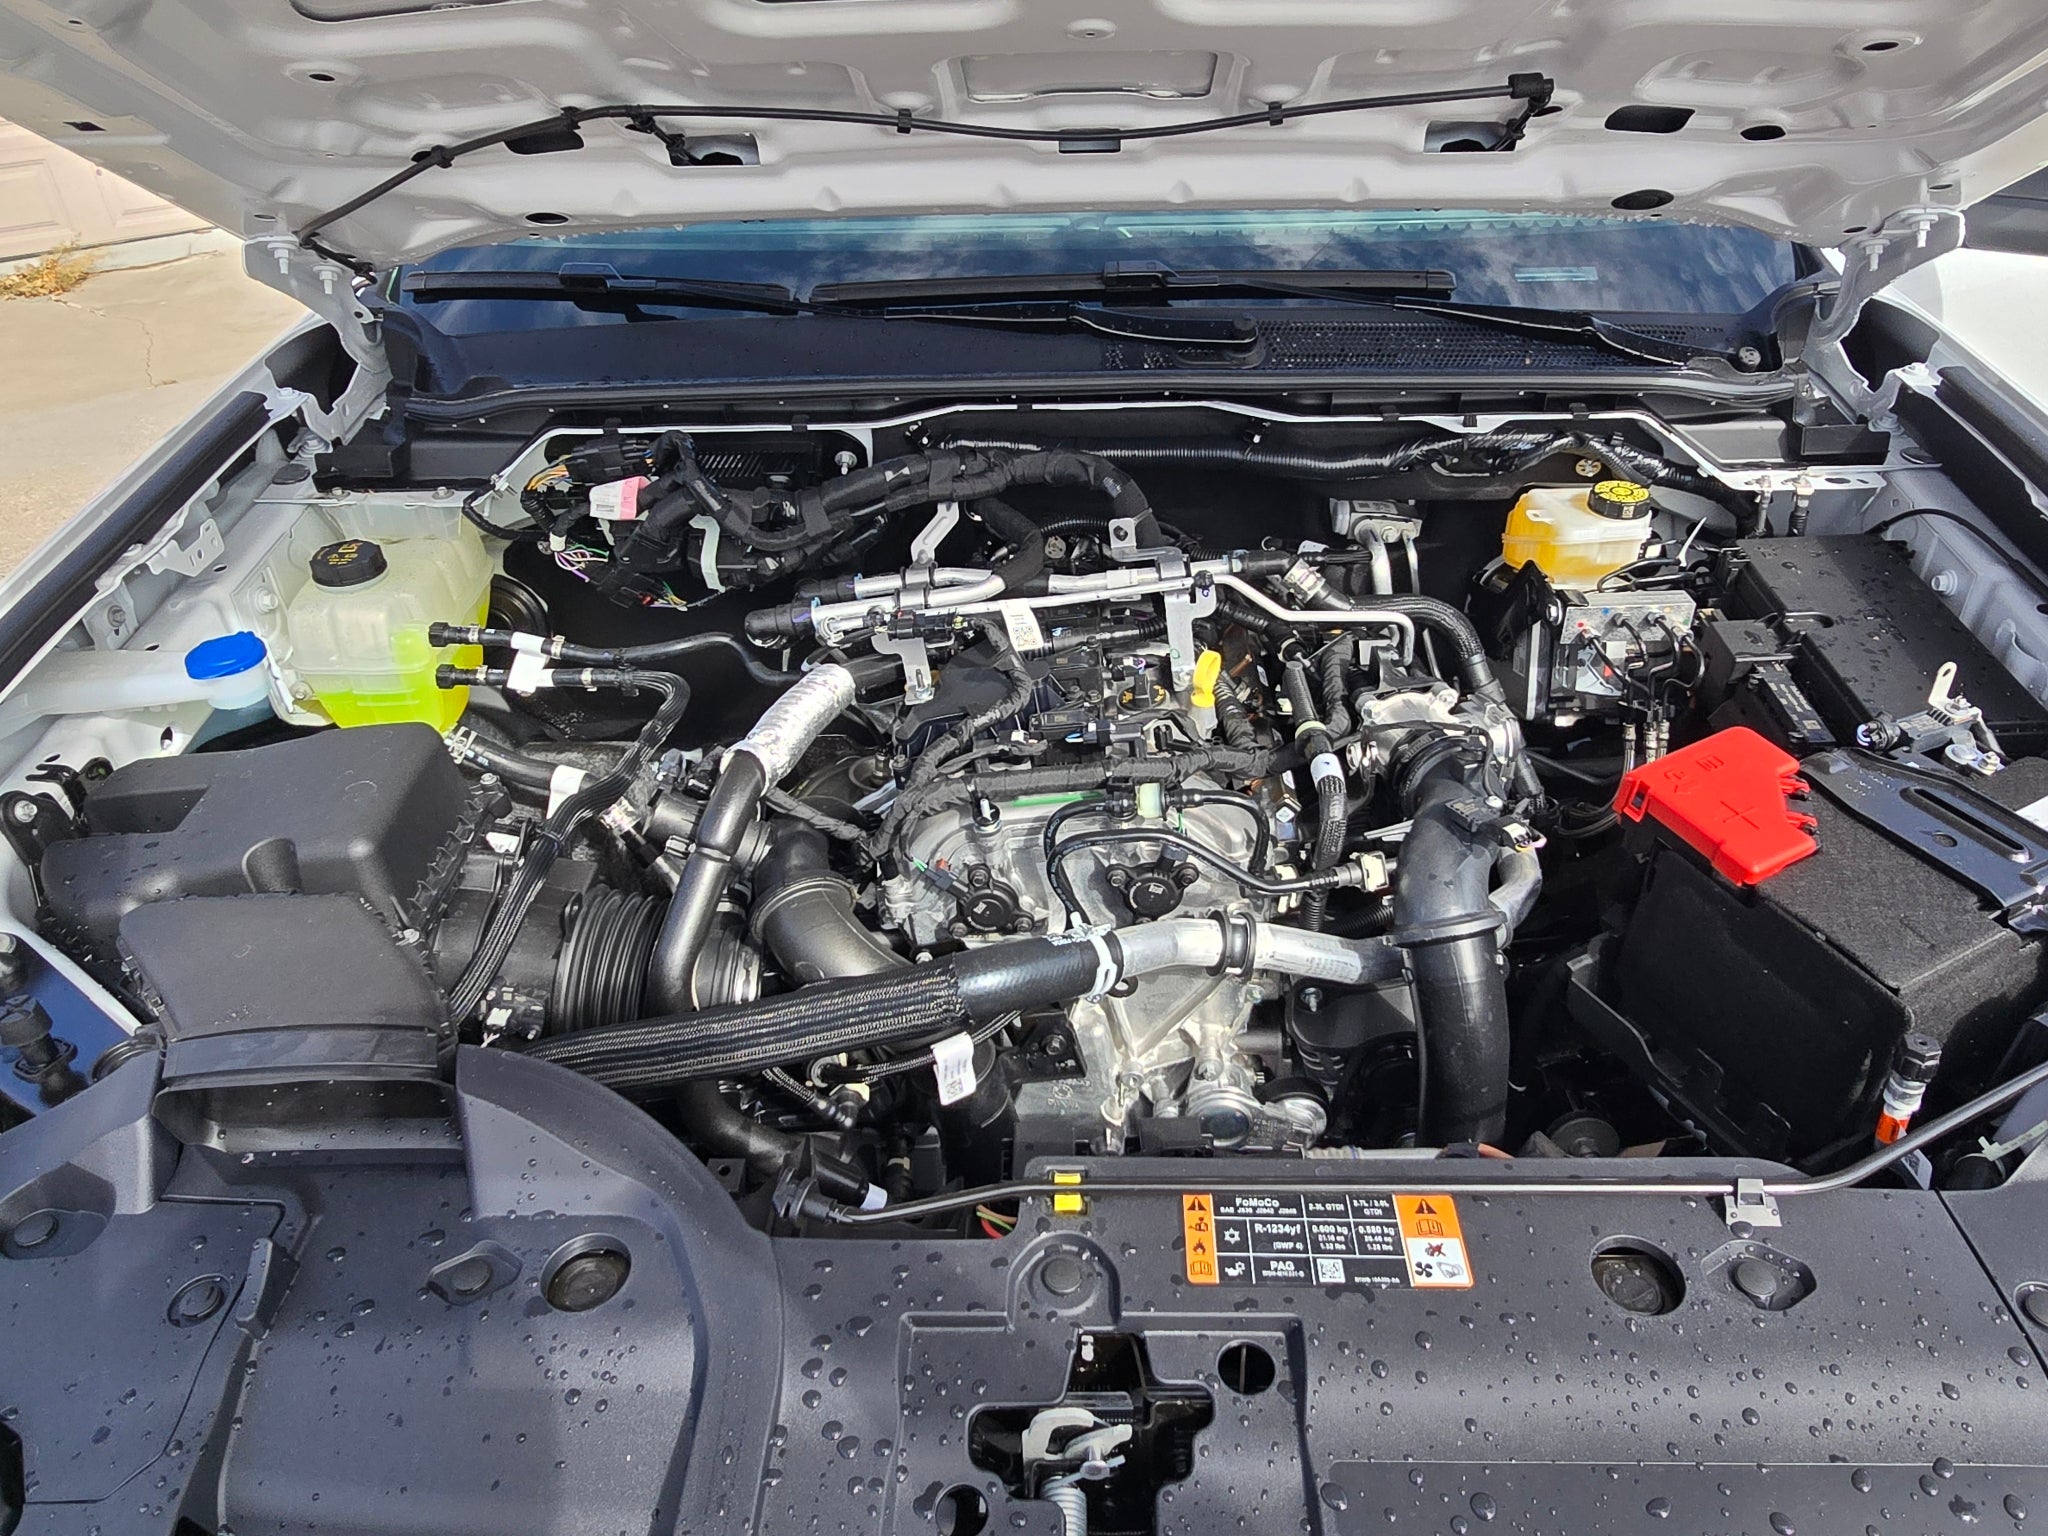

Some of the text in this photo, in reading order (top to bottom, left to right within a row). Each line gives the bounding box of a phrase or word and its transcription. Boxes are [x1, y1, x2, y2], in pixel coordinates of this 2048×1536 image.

[1235, 1197, 1280, 1207] FoMoCo
[1254, 1223, 1301, 1236] R-1234yf
[1312, 1225, 1348, 1235] 0.600 kg
[1383, 1226, 1395, 1236] kg
[1270, 1260, 1295, 1270] PAG
